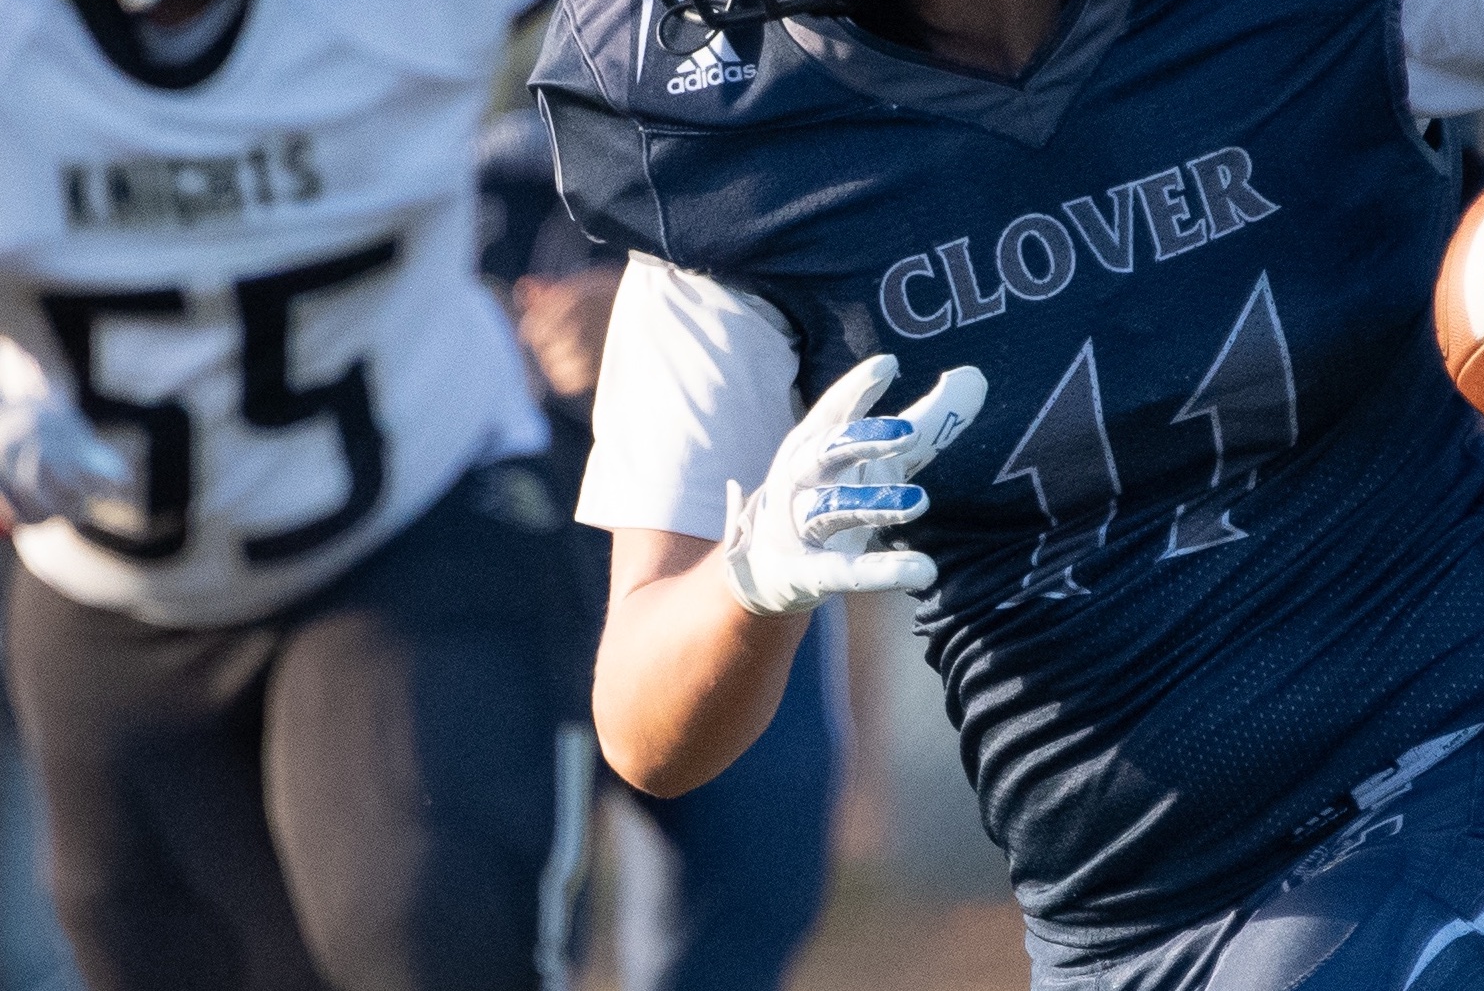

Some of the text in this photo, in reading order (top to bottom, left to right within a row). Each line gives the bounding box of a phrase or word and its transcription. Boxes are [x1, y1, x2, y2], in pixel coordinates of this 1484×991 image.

[666, 62, 758, 96] adidas
[879, 145, 1283, 339] CLOVER
[38, 235, 400, 569] 55
[992, 267, 1300, 611] 11
